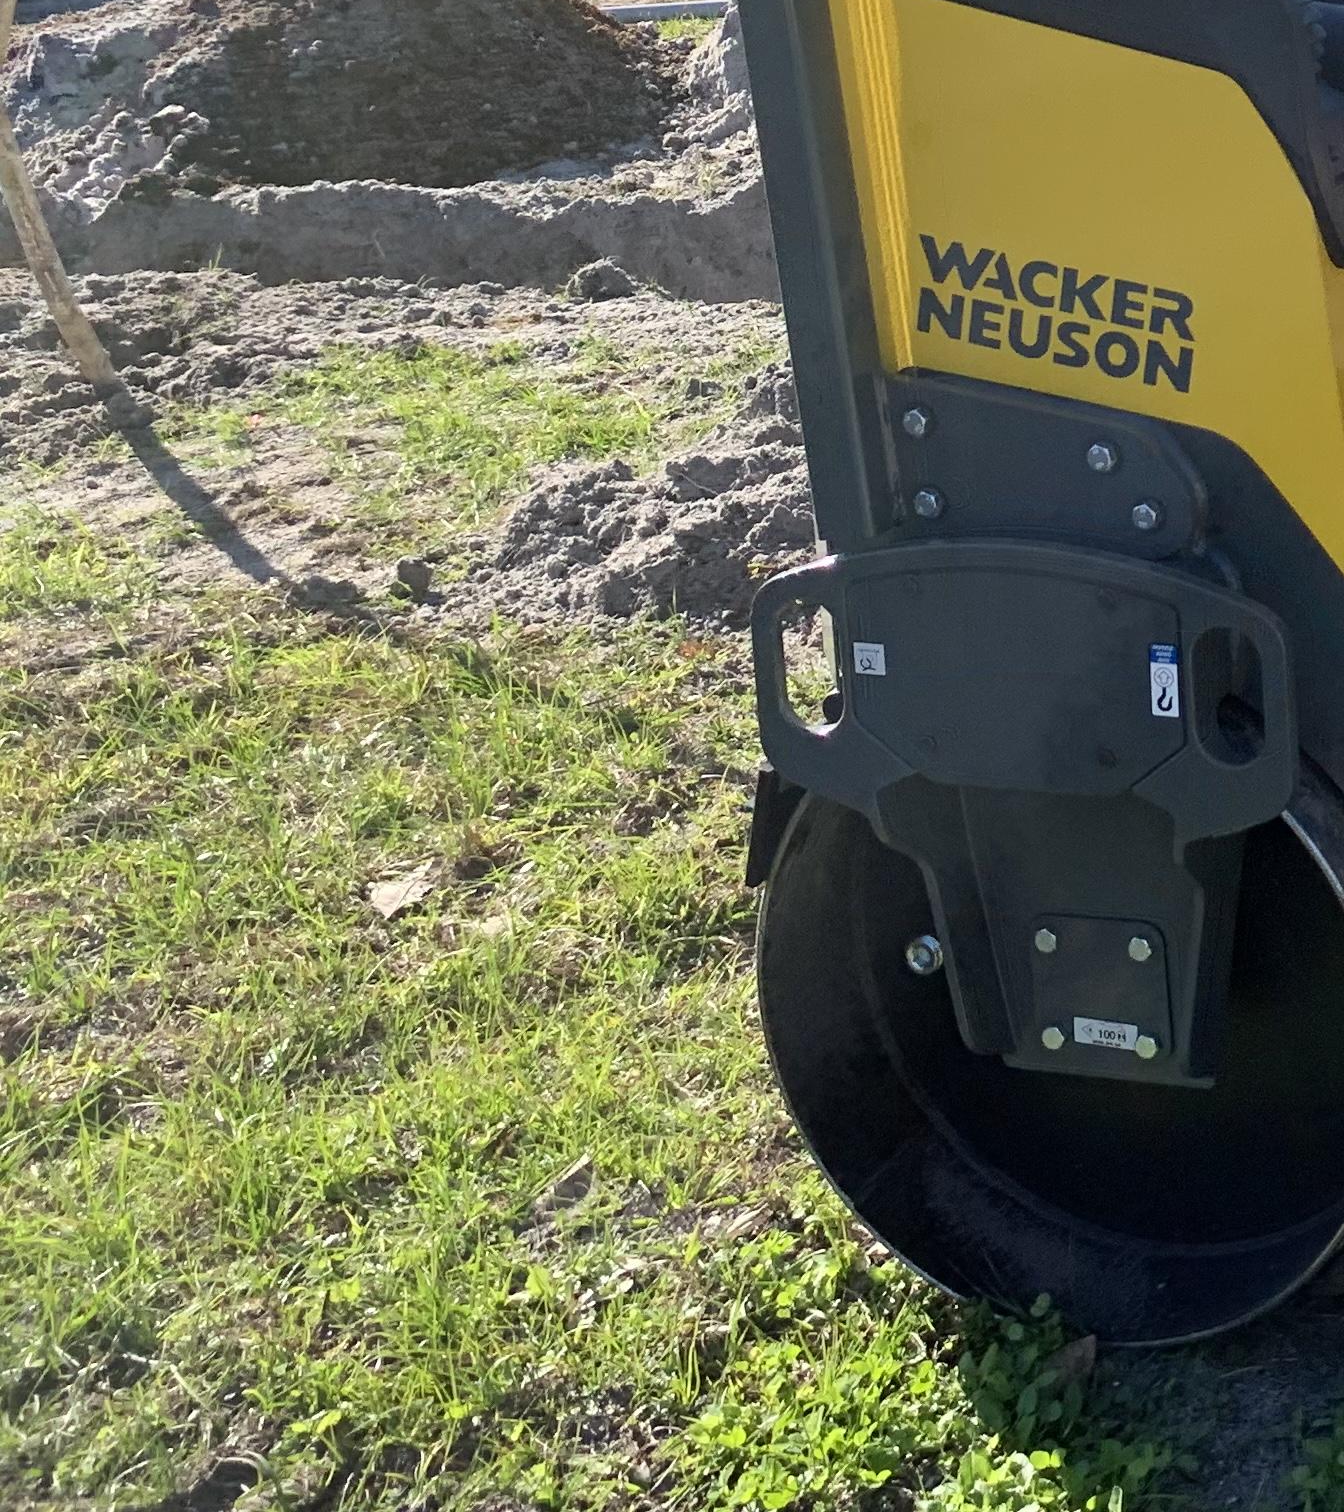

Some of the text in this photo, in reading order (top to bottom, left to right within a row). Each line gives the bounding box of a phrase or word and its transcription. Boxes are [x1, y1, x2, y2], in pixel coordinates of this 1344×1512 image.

[916, 287, 1195, 394] NEUSON
[918, 233, 1195, 342] WACKER
[1098, 1028, 1117, 1041] 100
